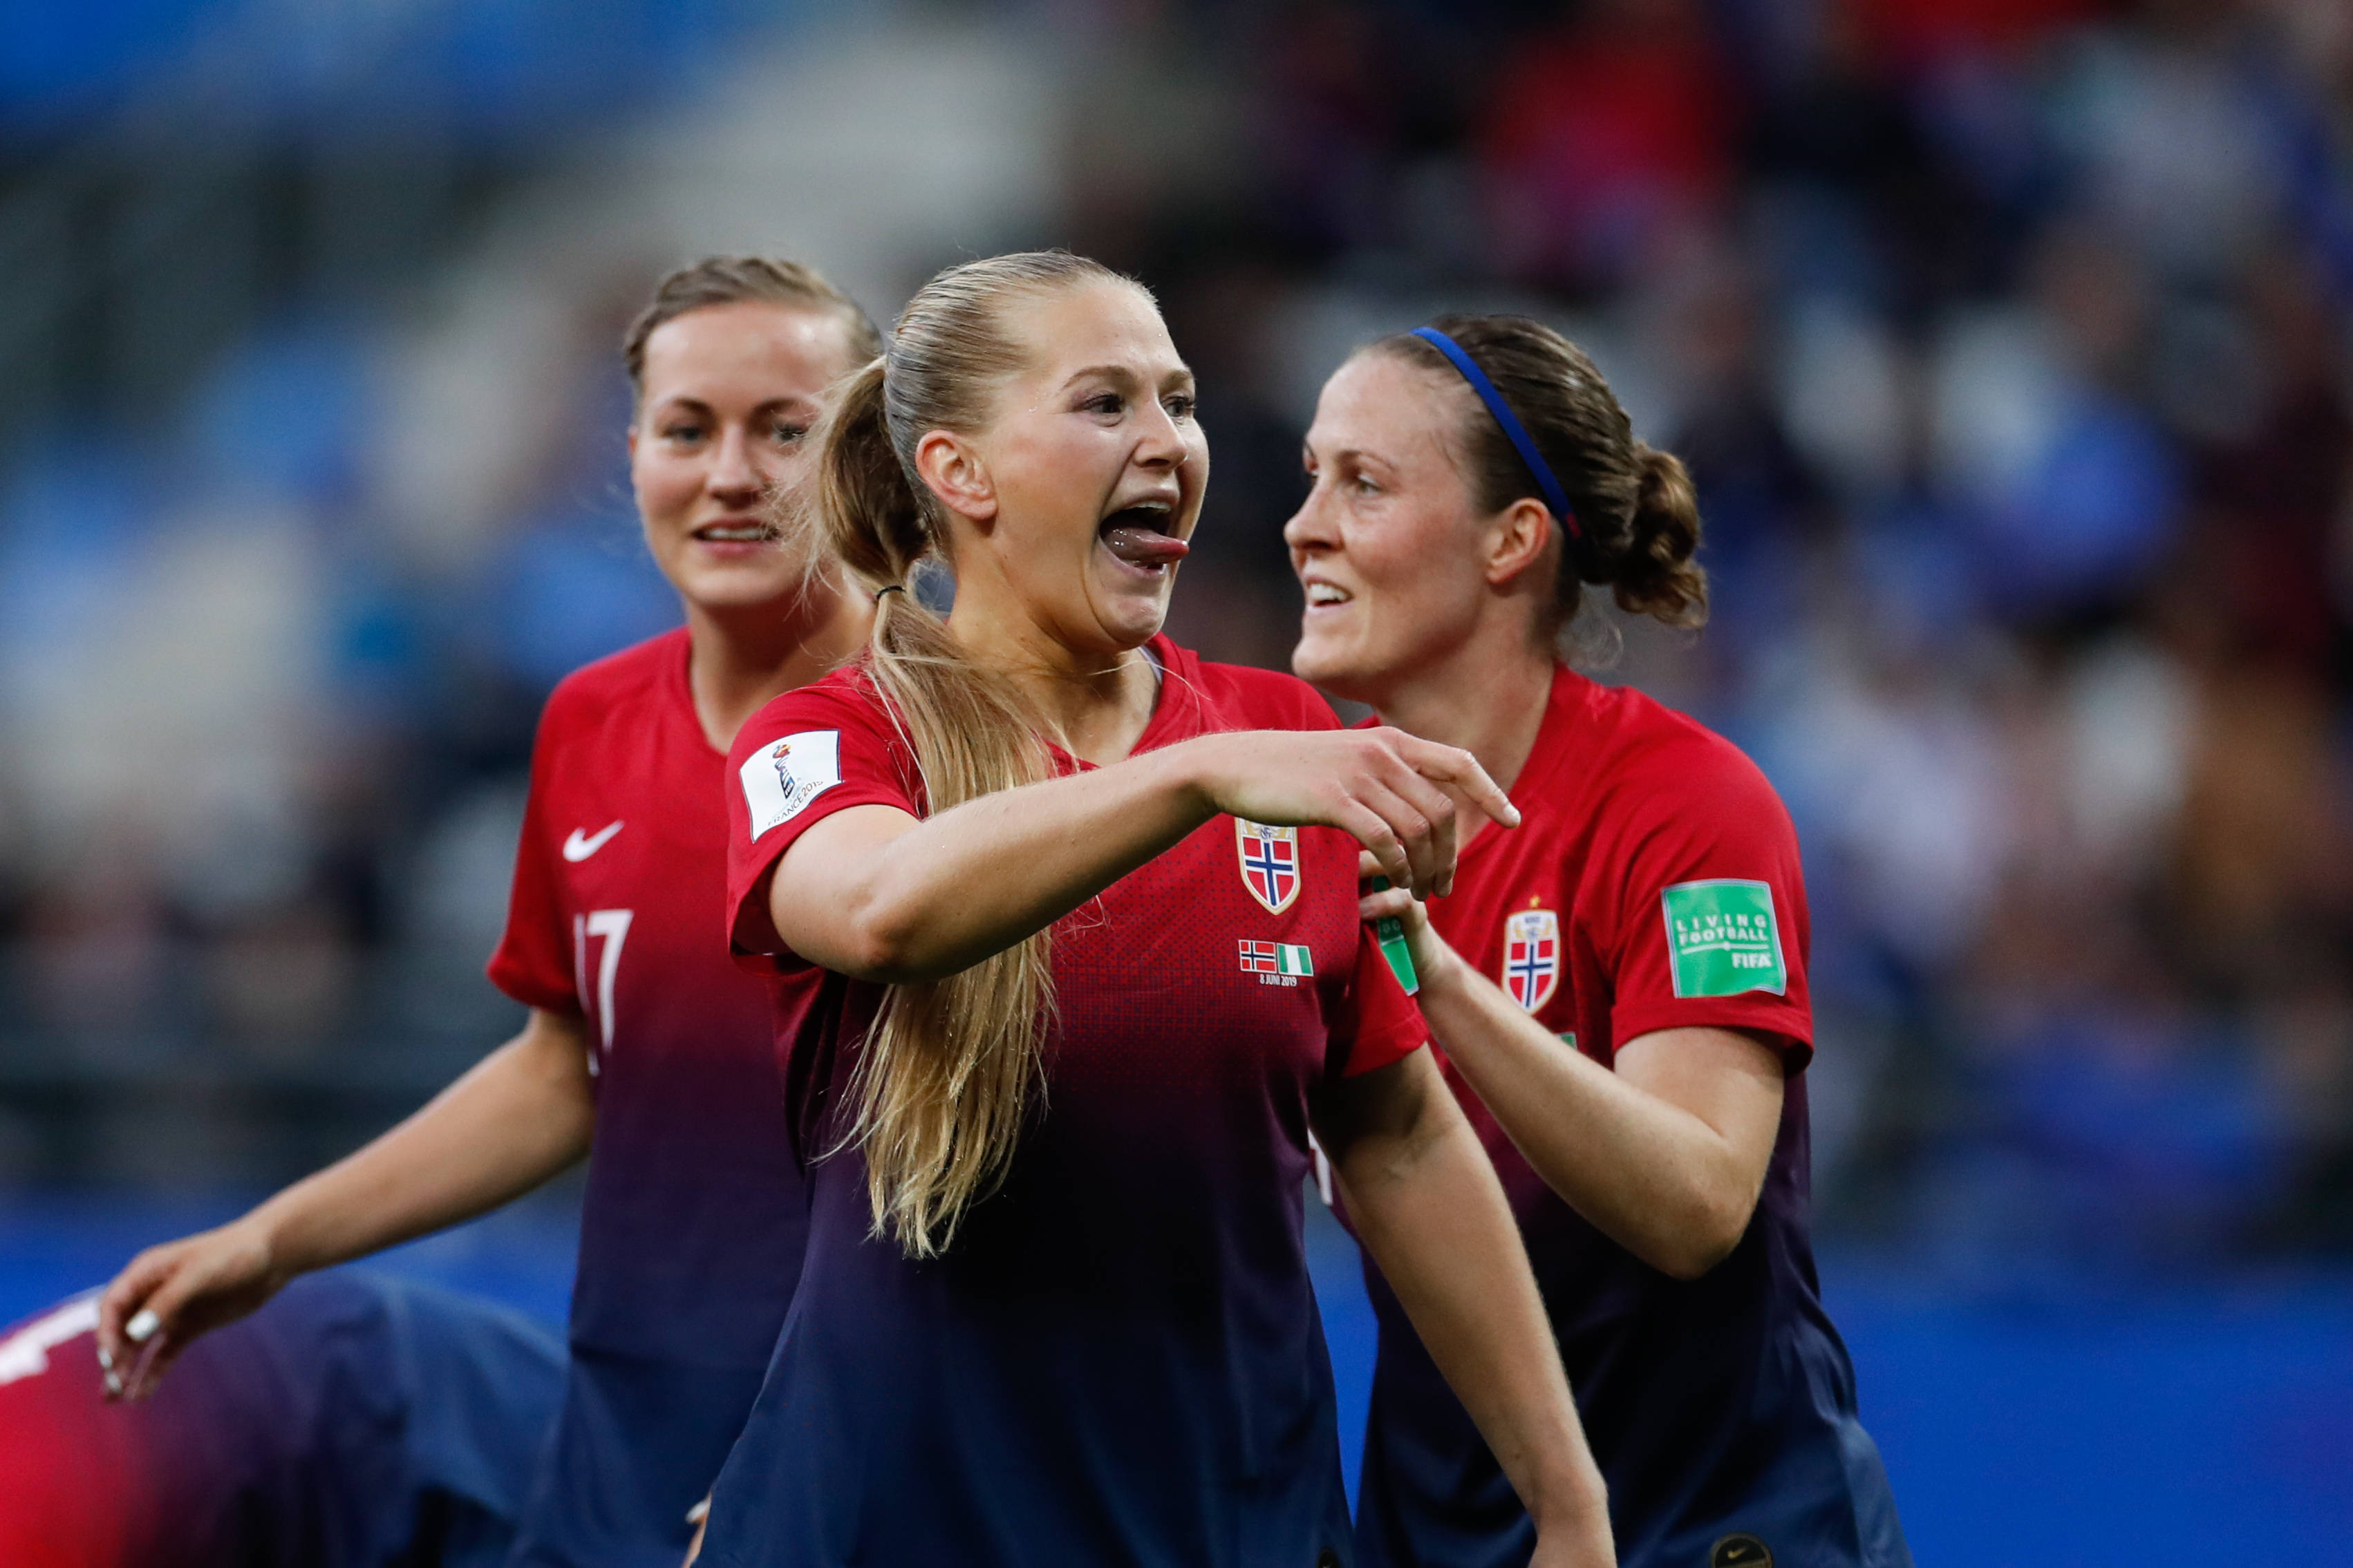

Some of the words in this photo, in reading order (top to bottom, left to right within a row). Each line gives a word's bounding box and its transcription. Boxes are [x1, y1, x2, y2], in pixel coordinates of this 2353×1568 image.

[1676, 913, 1768, 933] LIVING
[1678, 926, 1768, 947] FOOTBALL
[1731, 952, 1772, 969] FIFA
[1259, 973, 1265, 985] 8
[1266, 974, 1280, 986] JUNI
[1281, 975, 1297, 988] 2019
